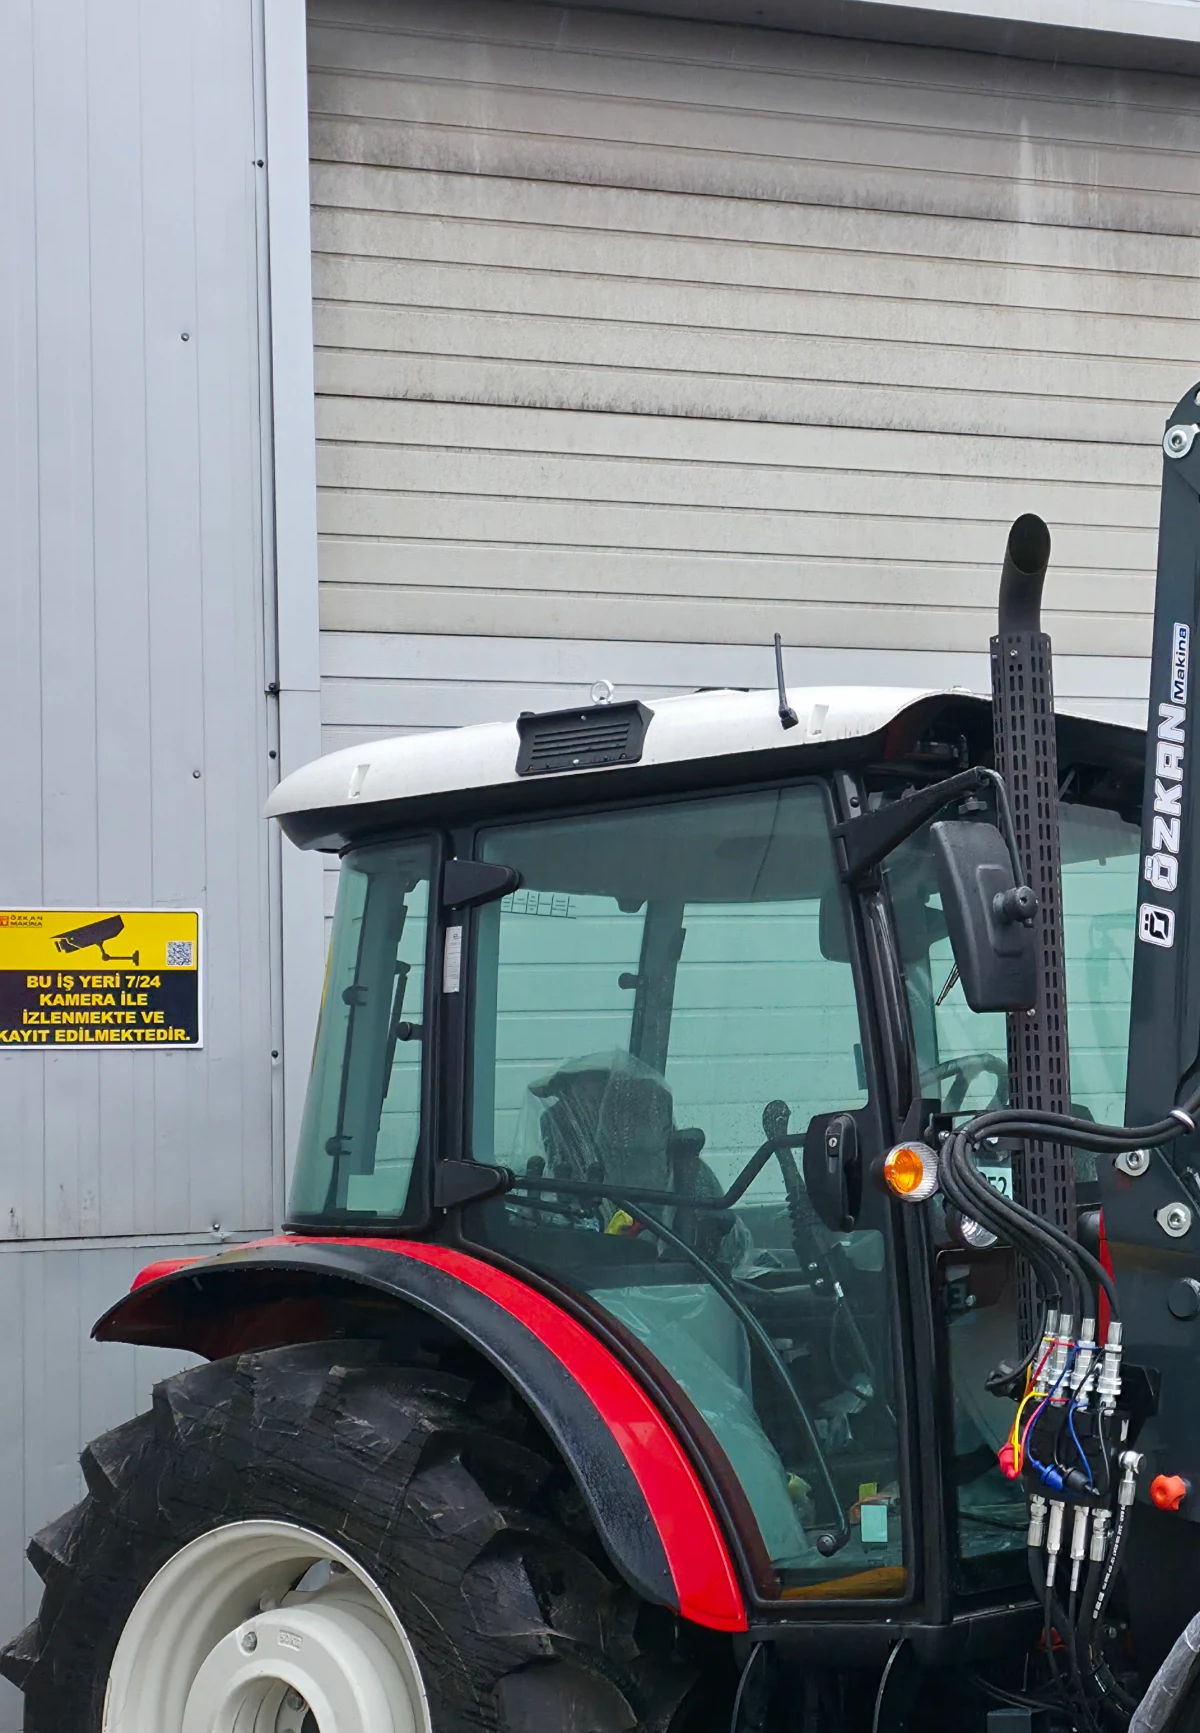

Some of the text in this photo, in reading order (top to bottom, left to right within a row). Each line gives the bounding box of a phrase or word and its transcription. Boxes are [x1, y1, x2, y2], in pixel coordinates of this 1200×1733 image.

[1144, 702, 1187, 893] ÖZKAN
[1174, 627, 1188, 701] Makina
[26, 972, 161, 991] BU İŞ YERİ 7/24
[40, 990, 148, 1006] KAMERA İLE
[23, 1009, 165, 1024] İZLENMEKTE VE
[55, 1026, 191, 1042] EDİLMEKTEDİR.
